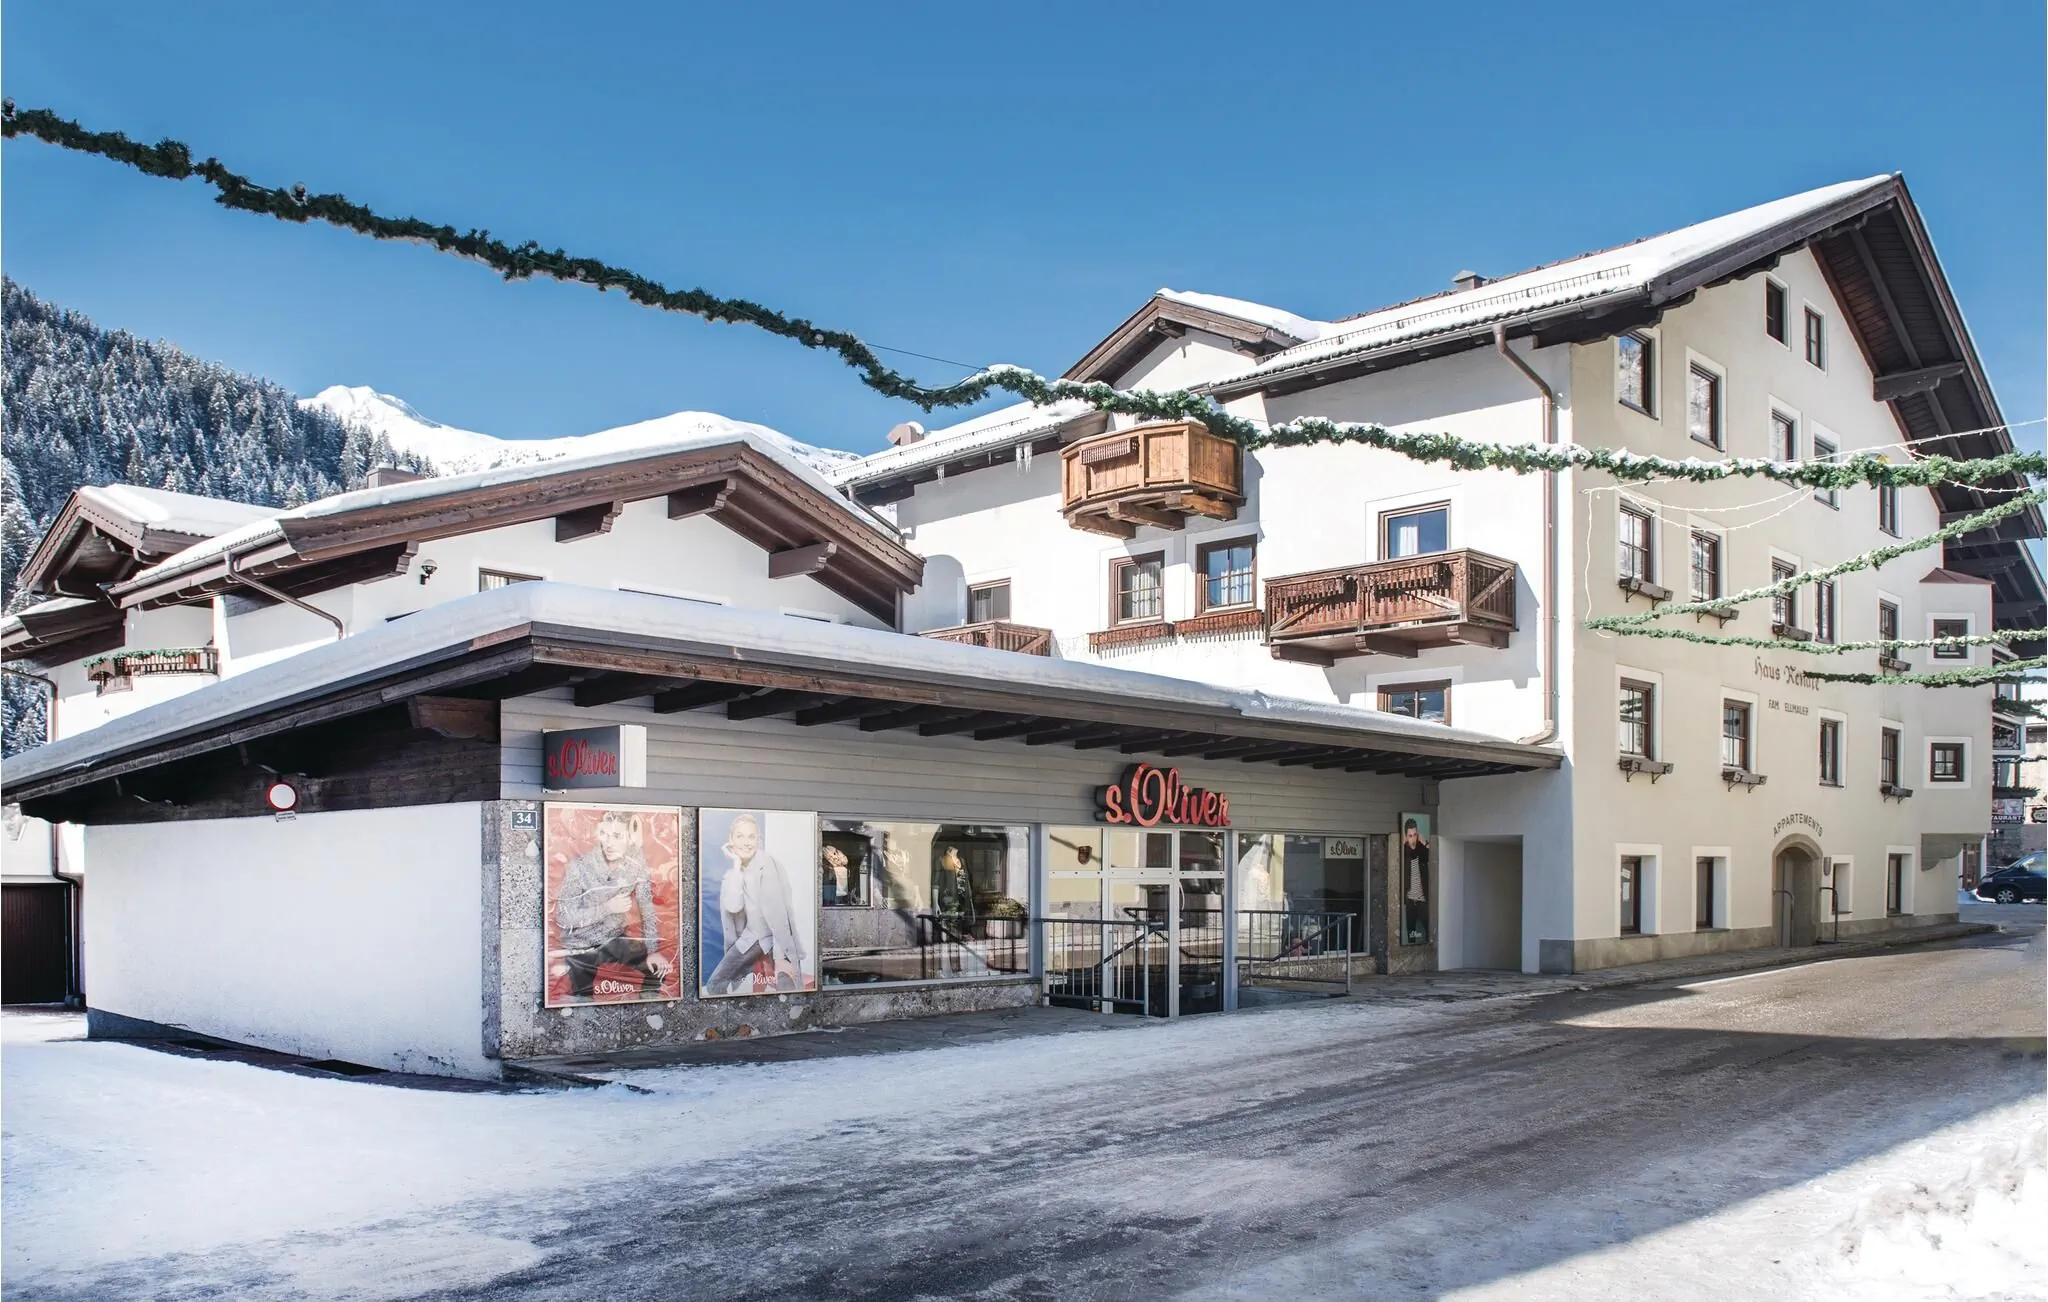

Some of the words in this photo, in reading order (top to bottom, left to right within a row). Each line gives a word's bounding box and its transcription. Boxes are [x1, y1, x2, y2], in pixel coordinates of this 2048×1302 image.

[1754, 656, 1780, 681] Haus
[549, 736, 617, 779] s.Oliver
[1104, 762, 1232, 827] s.Oliver
[516, 812, 532, 824] 34
[1772, 812, 1824, 838] APPARTEMENTS
[594, 980, 636, 995] s.Oliver
